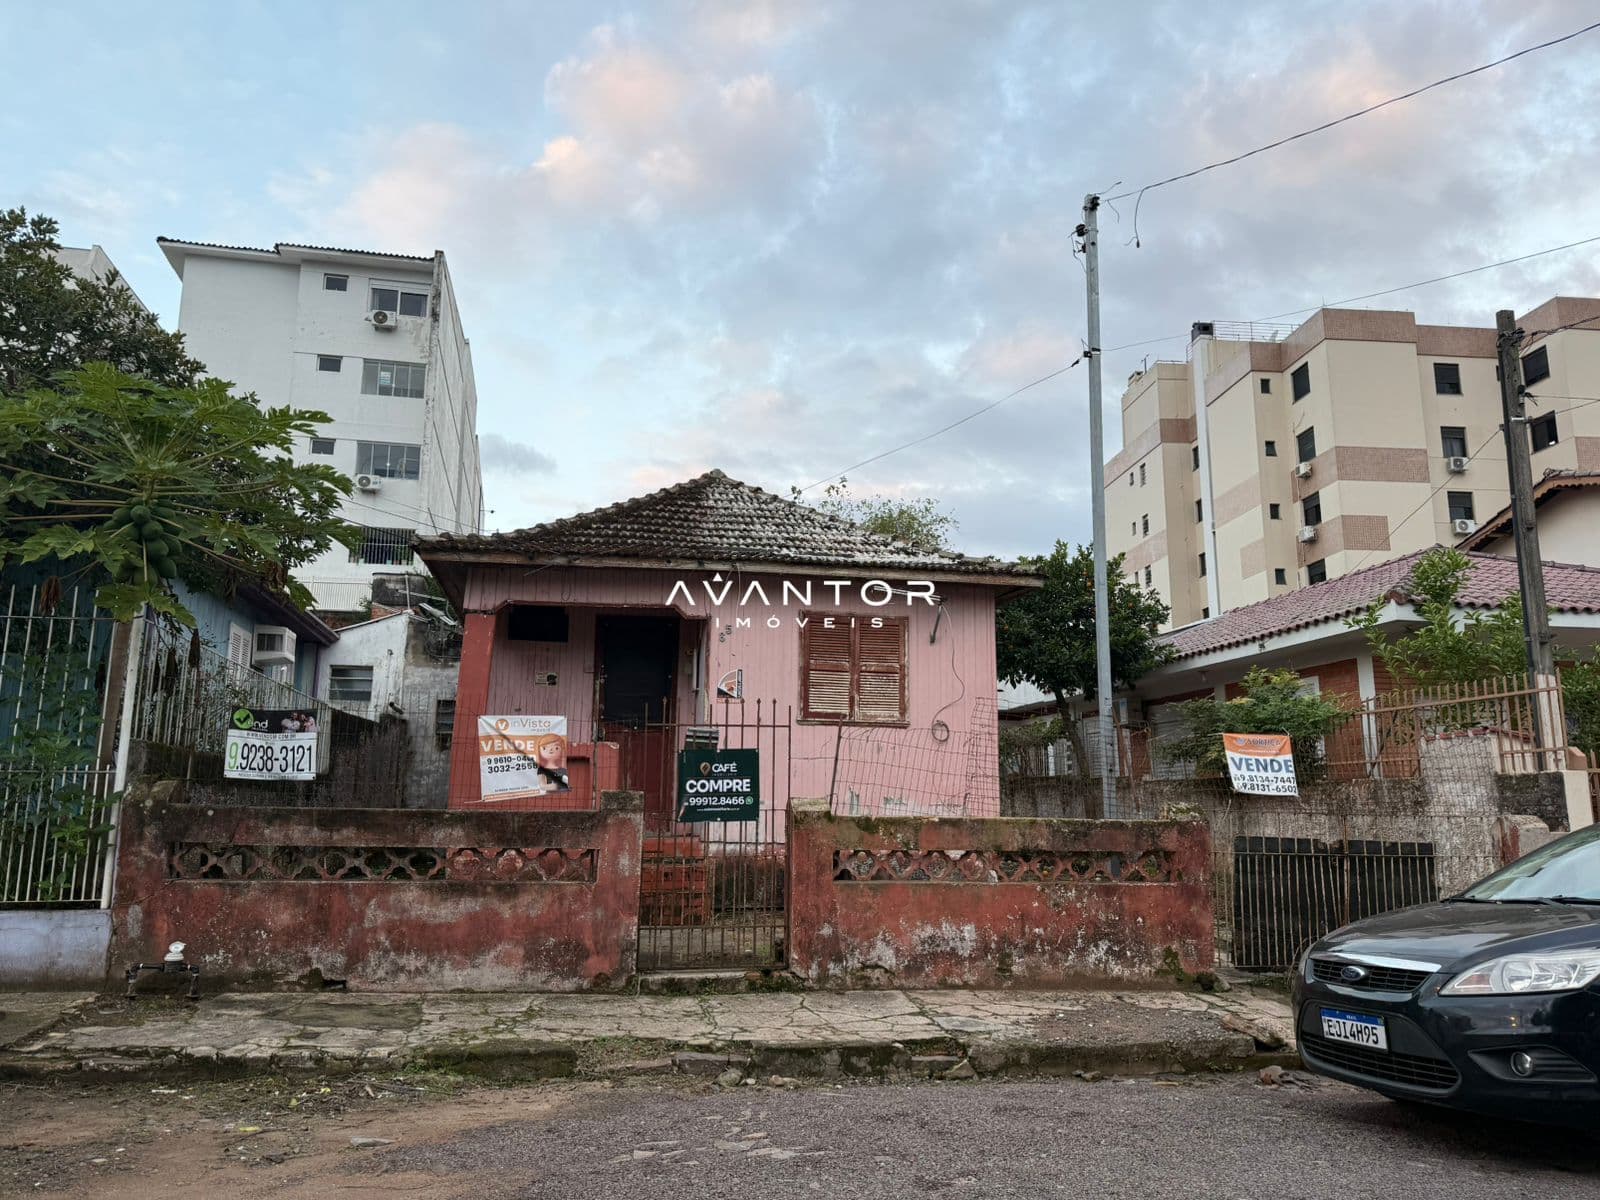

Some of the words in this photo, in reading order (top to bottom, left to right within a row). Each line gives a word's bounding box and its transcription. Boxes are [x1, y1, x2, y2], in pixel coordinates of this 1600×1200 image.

[480, 739, 535, 753] VENDE
[228, 741, 312, 773] 9.9238-3121
[711, 761, 738, 773] CAFÉ
[1230, 756, 1294, 773] VENDE
[685, 779, 751, 793] COMPRE
